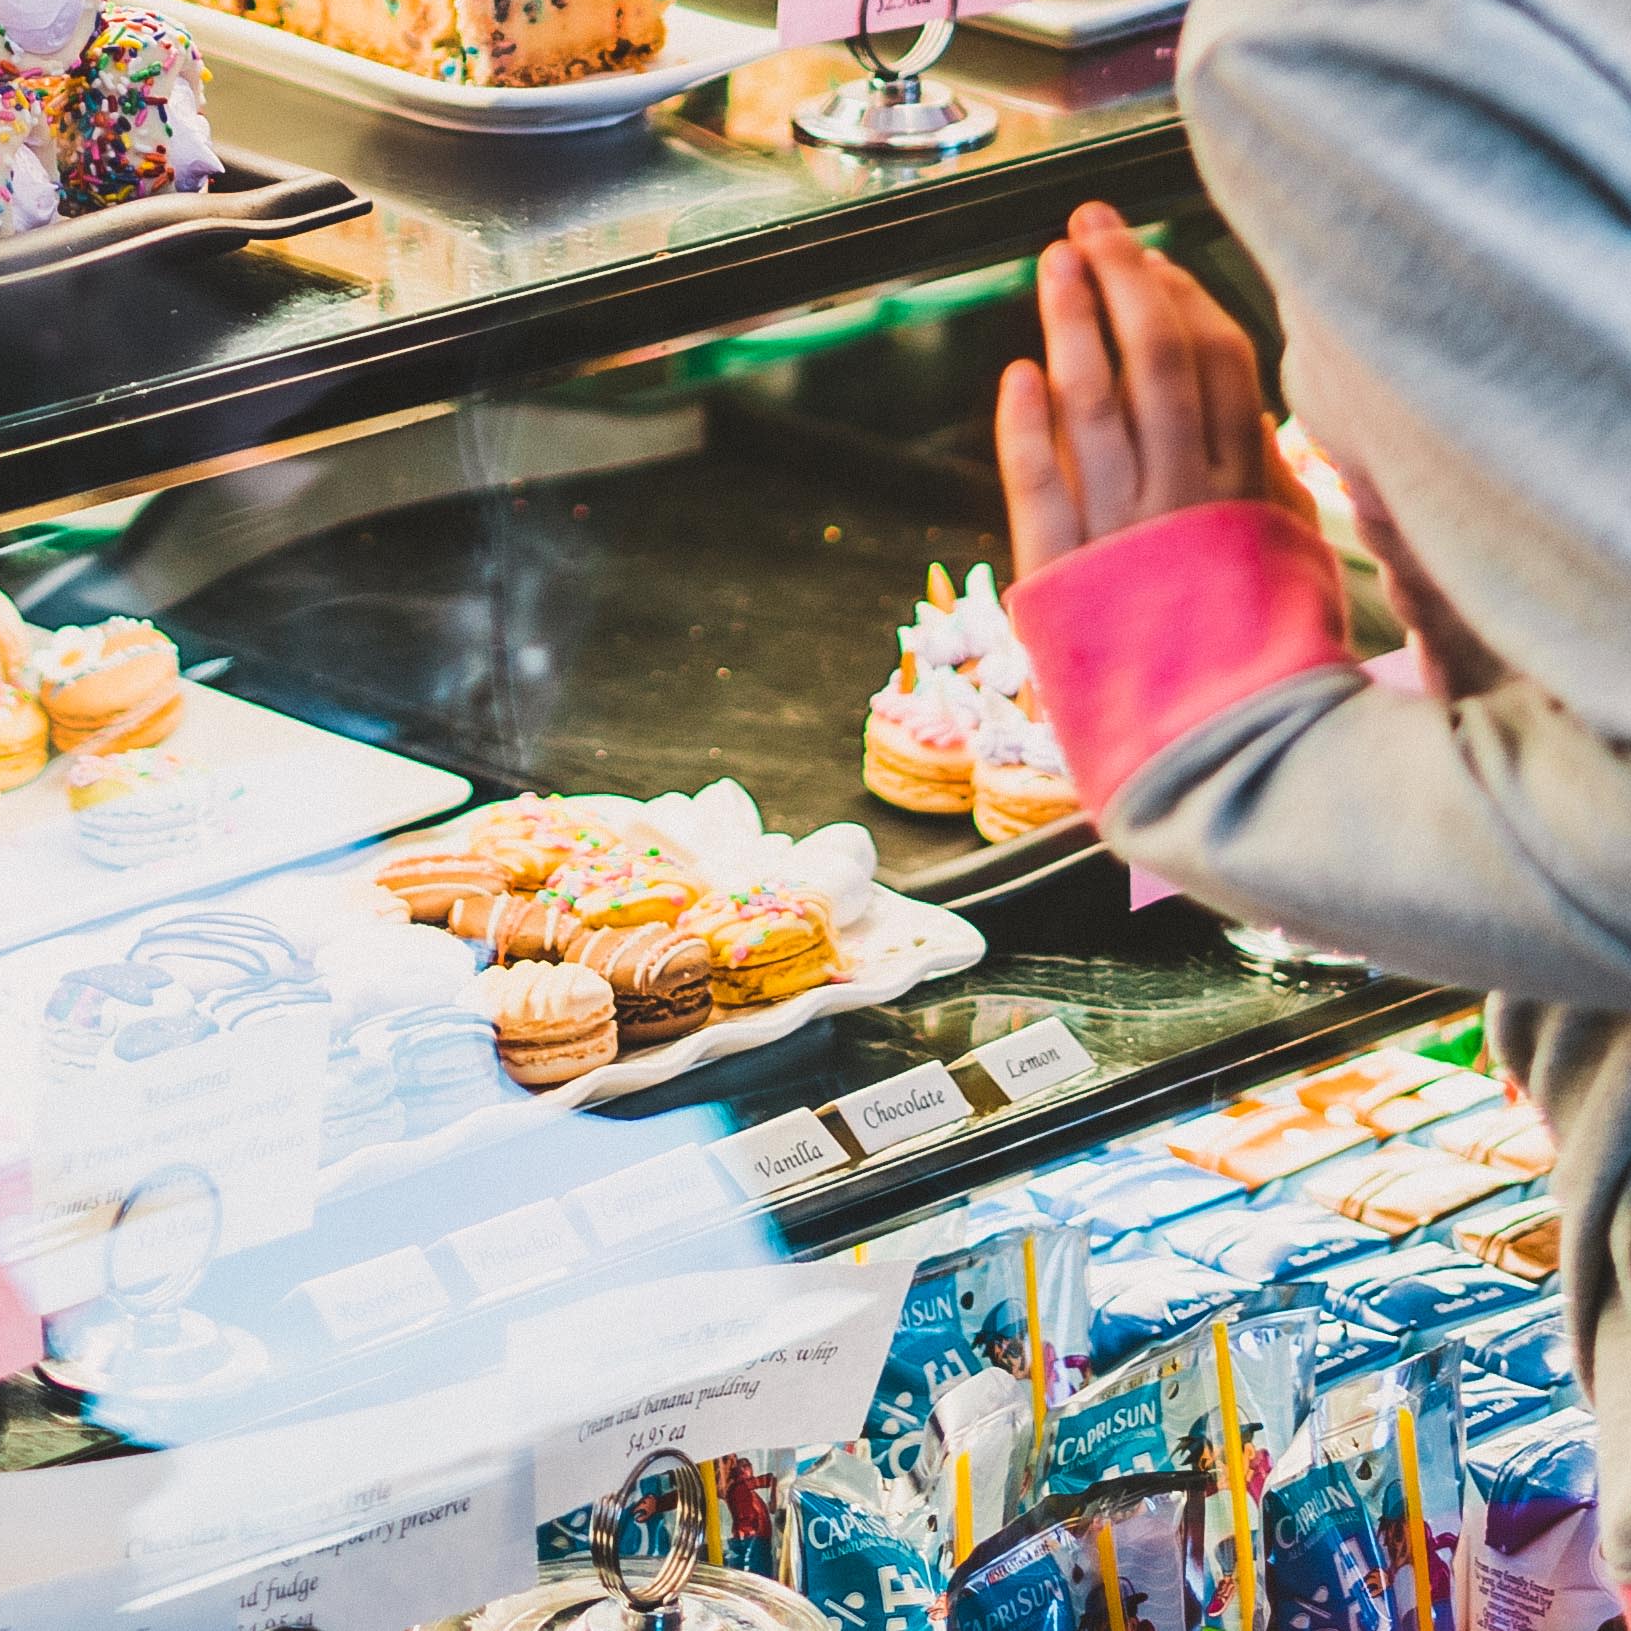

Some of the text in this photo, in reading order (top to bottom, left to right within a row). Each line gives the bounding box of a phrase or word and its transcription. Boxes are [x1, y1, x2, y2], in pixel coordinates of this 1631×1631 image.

[1005, 1045, 1061, 1079] Lemon
[862, 1087, 946, 1130] Chocolate
[754, 1142, 824, 1179] Vanilla
[796, 1340, 838, 1368] whip
[616, 1398, 642, 1426] and
[644, 1387, 695, 1423] banana
[697, 1376, 761, 1413] pudding
[625, 1421, 686, 1459] $4.95 ea
[400, 1495, 472, 1536] preserve
[261, 1571, 319, 1611] fudge
